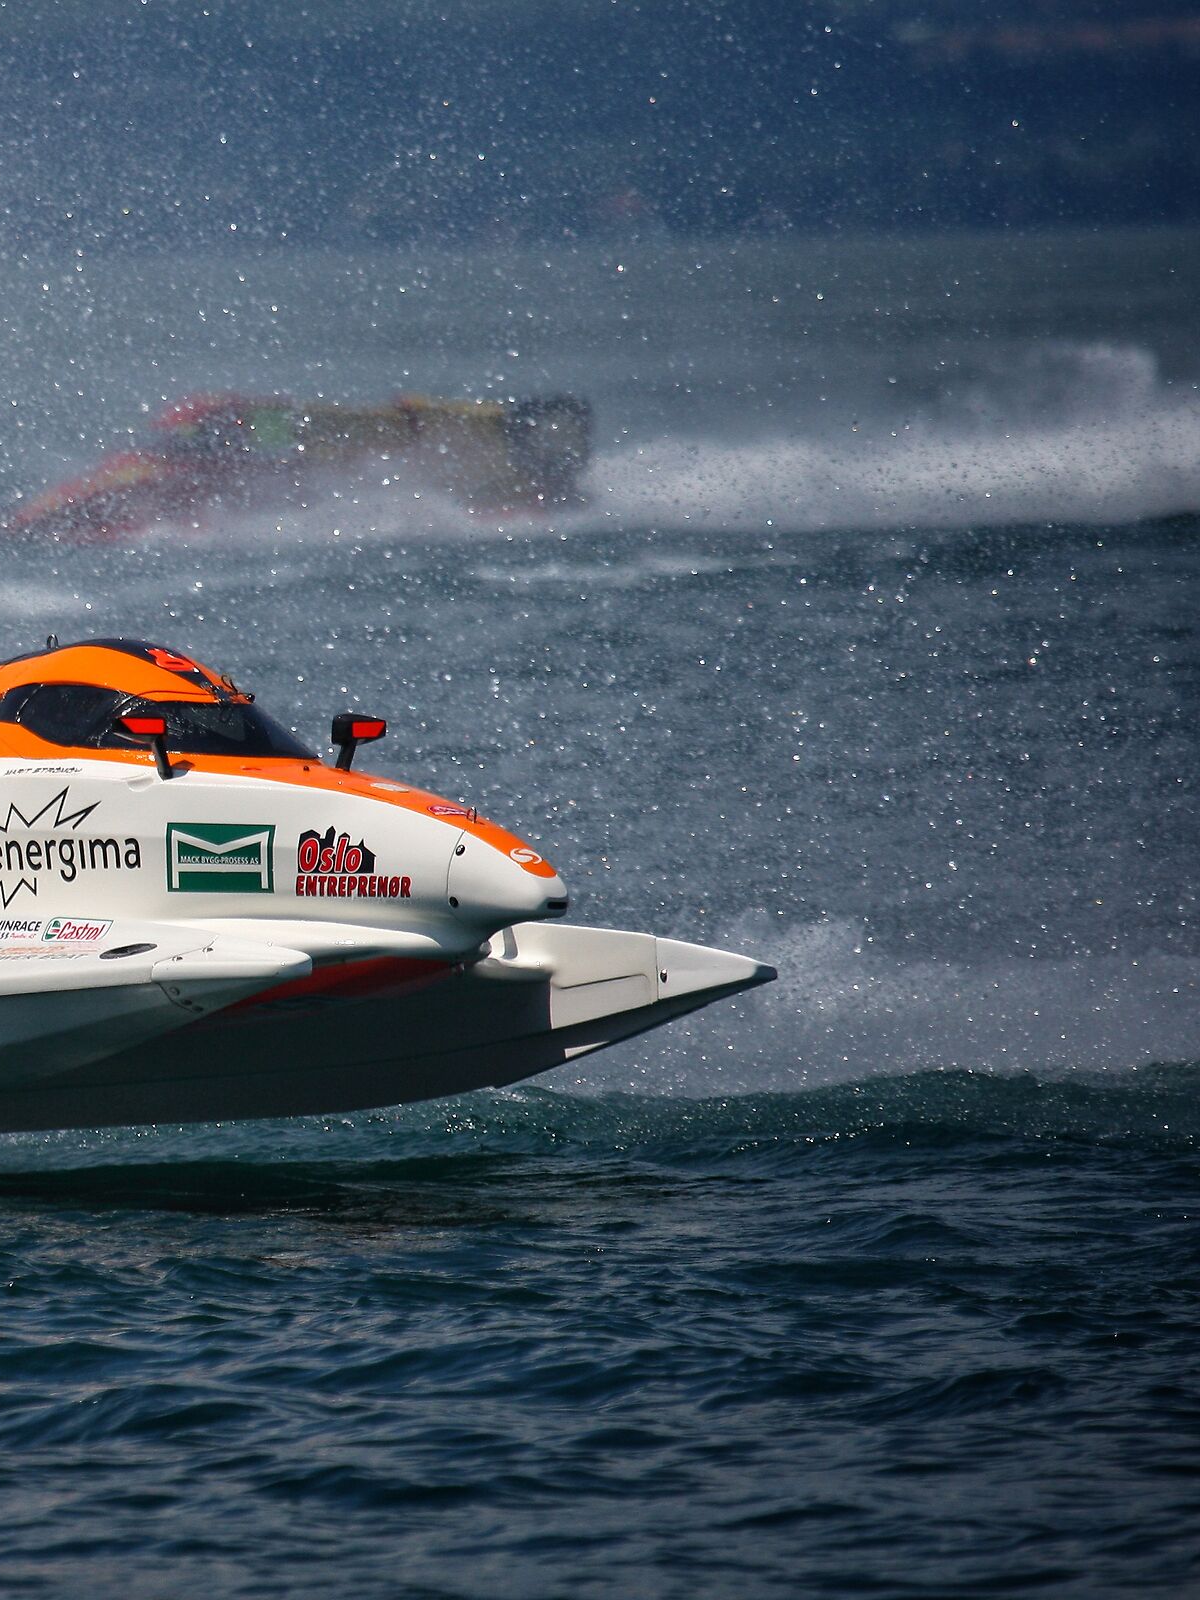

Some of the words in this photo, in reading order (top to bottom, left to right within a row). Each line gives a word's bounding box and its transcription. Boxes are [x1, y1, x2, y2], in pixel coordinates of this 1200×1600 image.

[180, 856, 200, 864] MACK
[201, 856, 248, 864] BYGG-PROSESS
[299, 837, 362, 873] Oslo
[296, 876, 411, 898] ENTREPRENØR
[56, 922, 106, 940] Castrol
